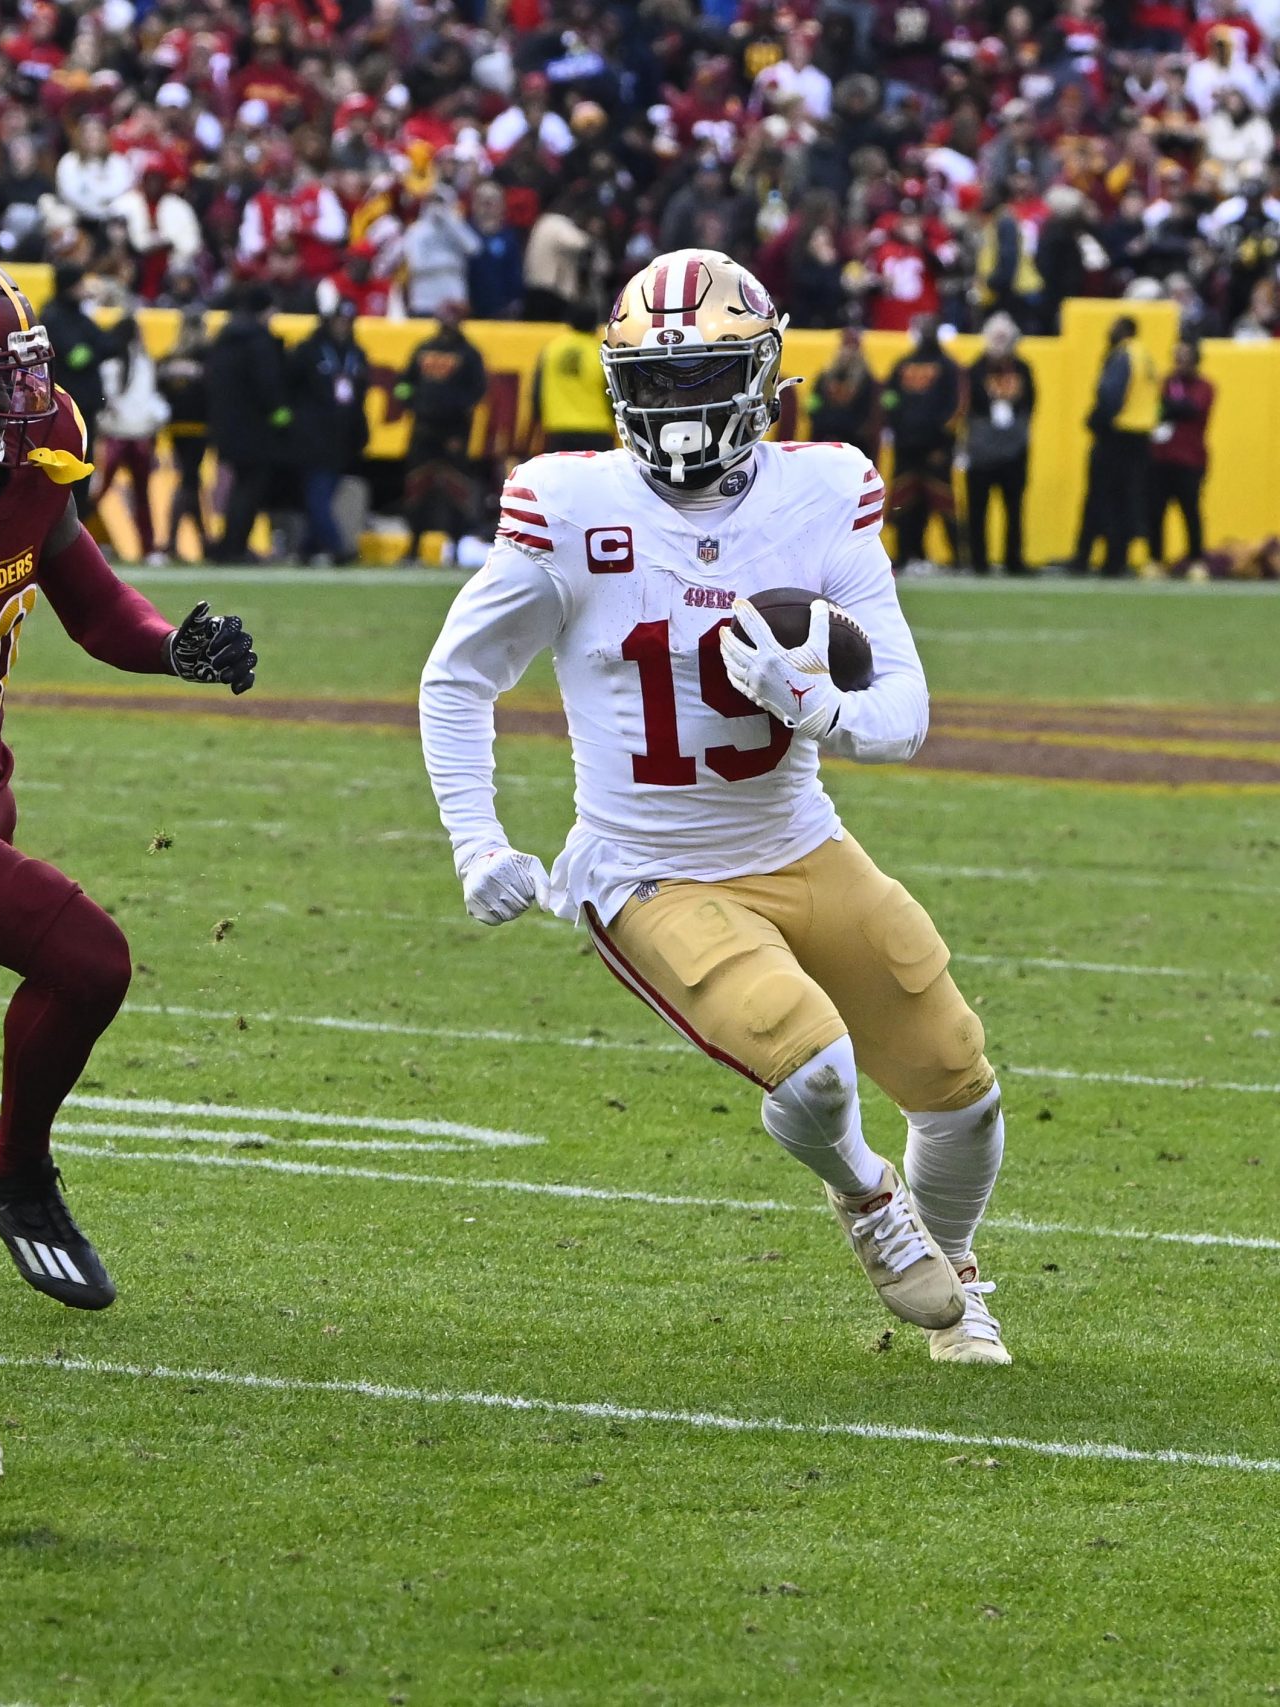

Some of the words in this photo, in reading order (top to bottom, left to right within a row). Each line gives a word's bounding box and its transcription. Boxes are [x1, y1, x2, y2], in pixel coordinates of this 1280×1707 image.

[590, 530, 630, 562] C
[700, 548, 717, 560] NFL
[683, 587, 737, 609] 49ERS
